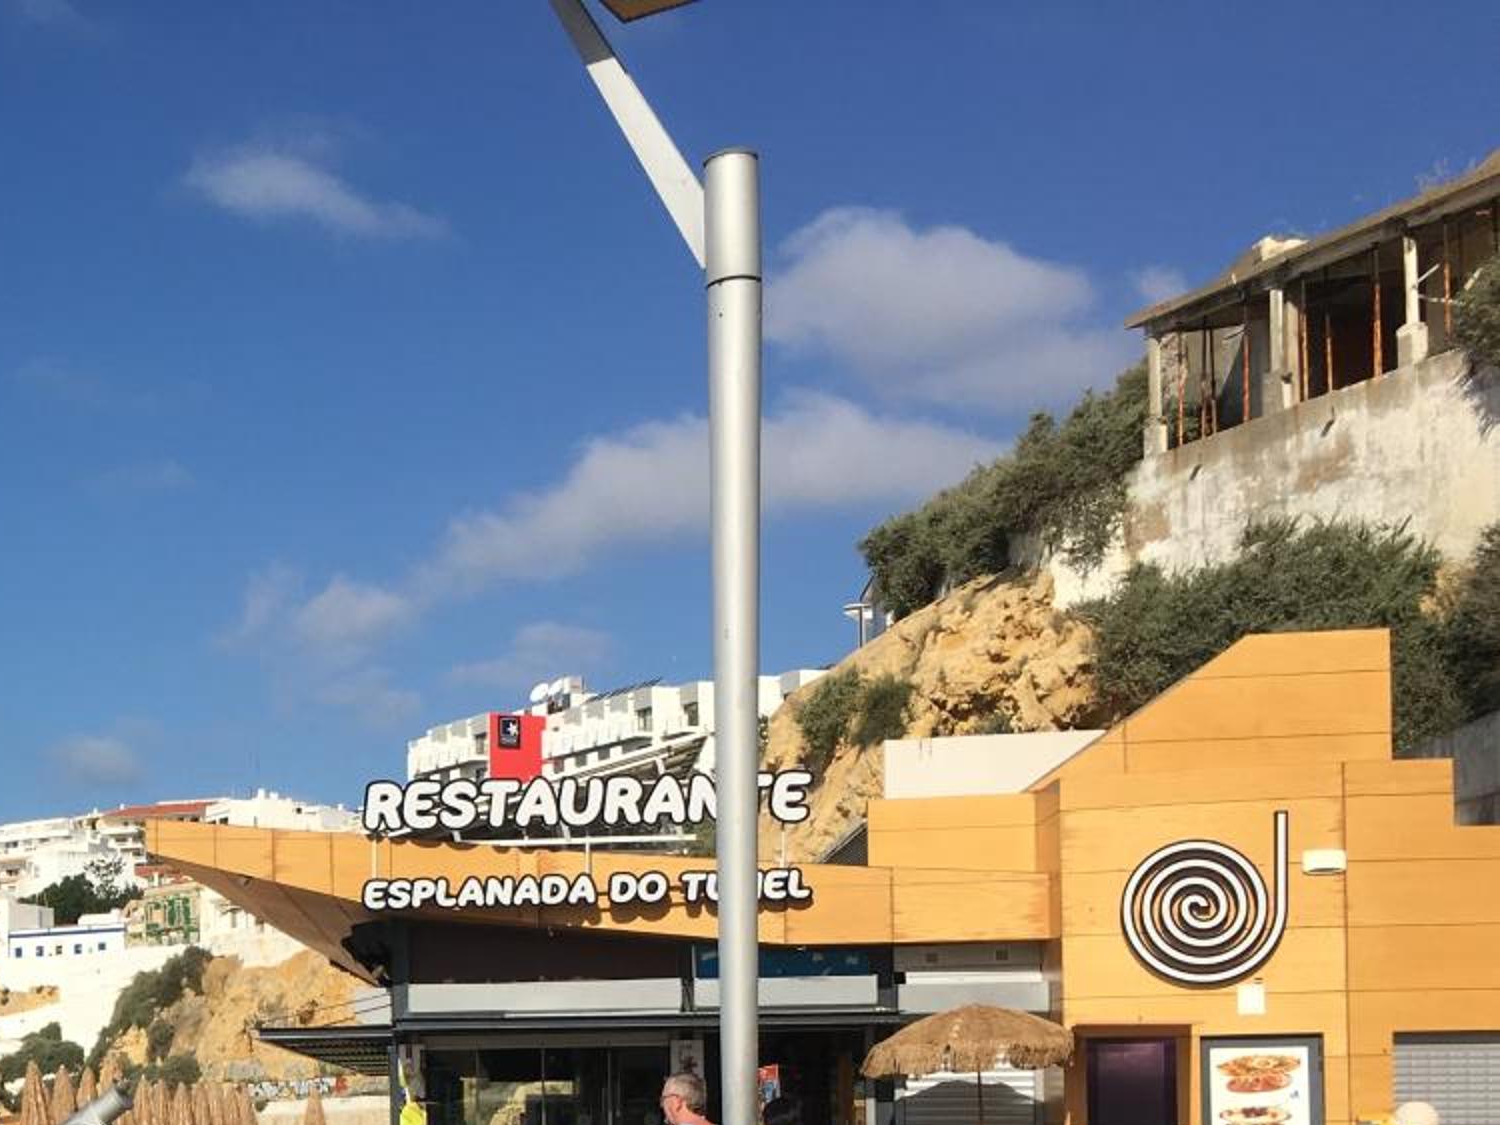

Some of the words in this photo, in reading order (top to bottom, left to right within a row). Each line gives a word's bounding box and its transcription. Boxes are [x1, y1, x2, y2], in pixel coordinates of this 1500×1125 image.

[364, 771, 813, 832] RESTAURANE
[362, 872, 598, 910] ESPLANADA
[607, 870, 671, 904] DO
[679, 867, 813, 903] TEL
